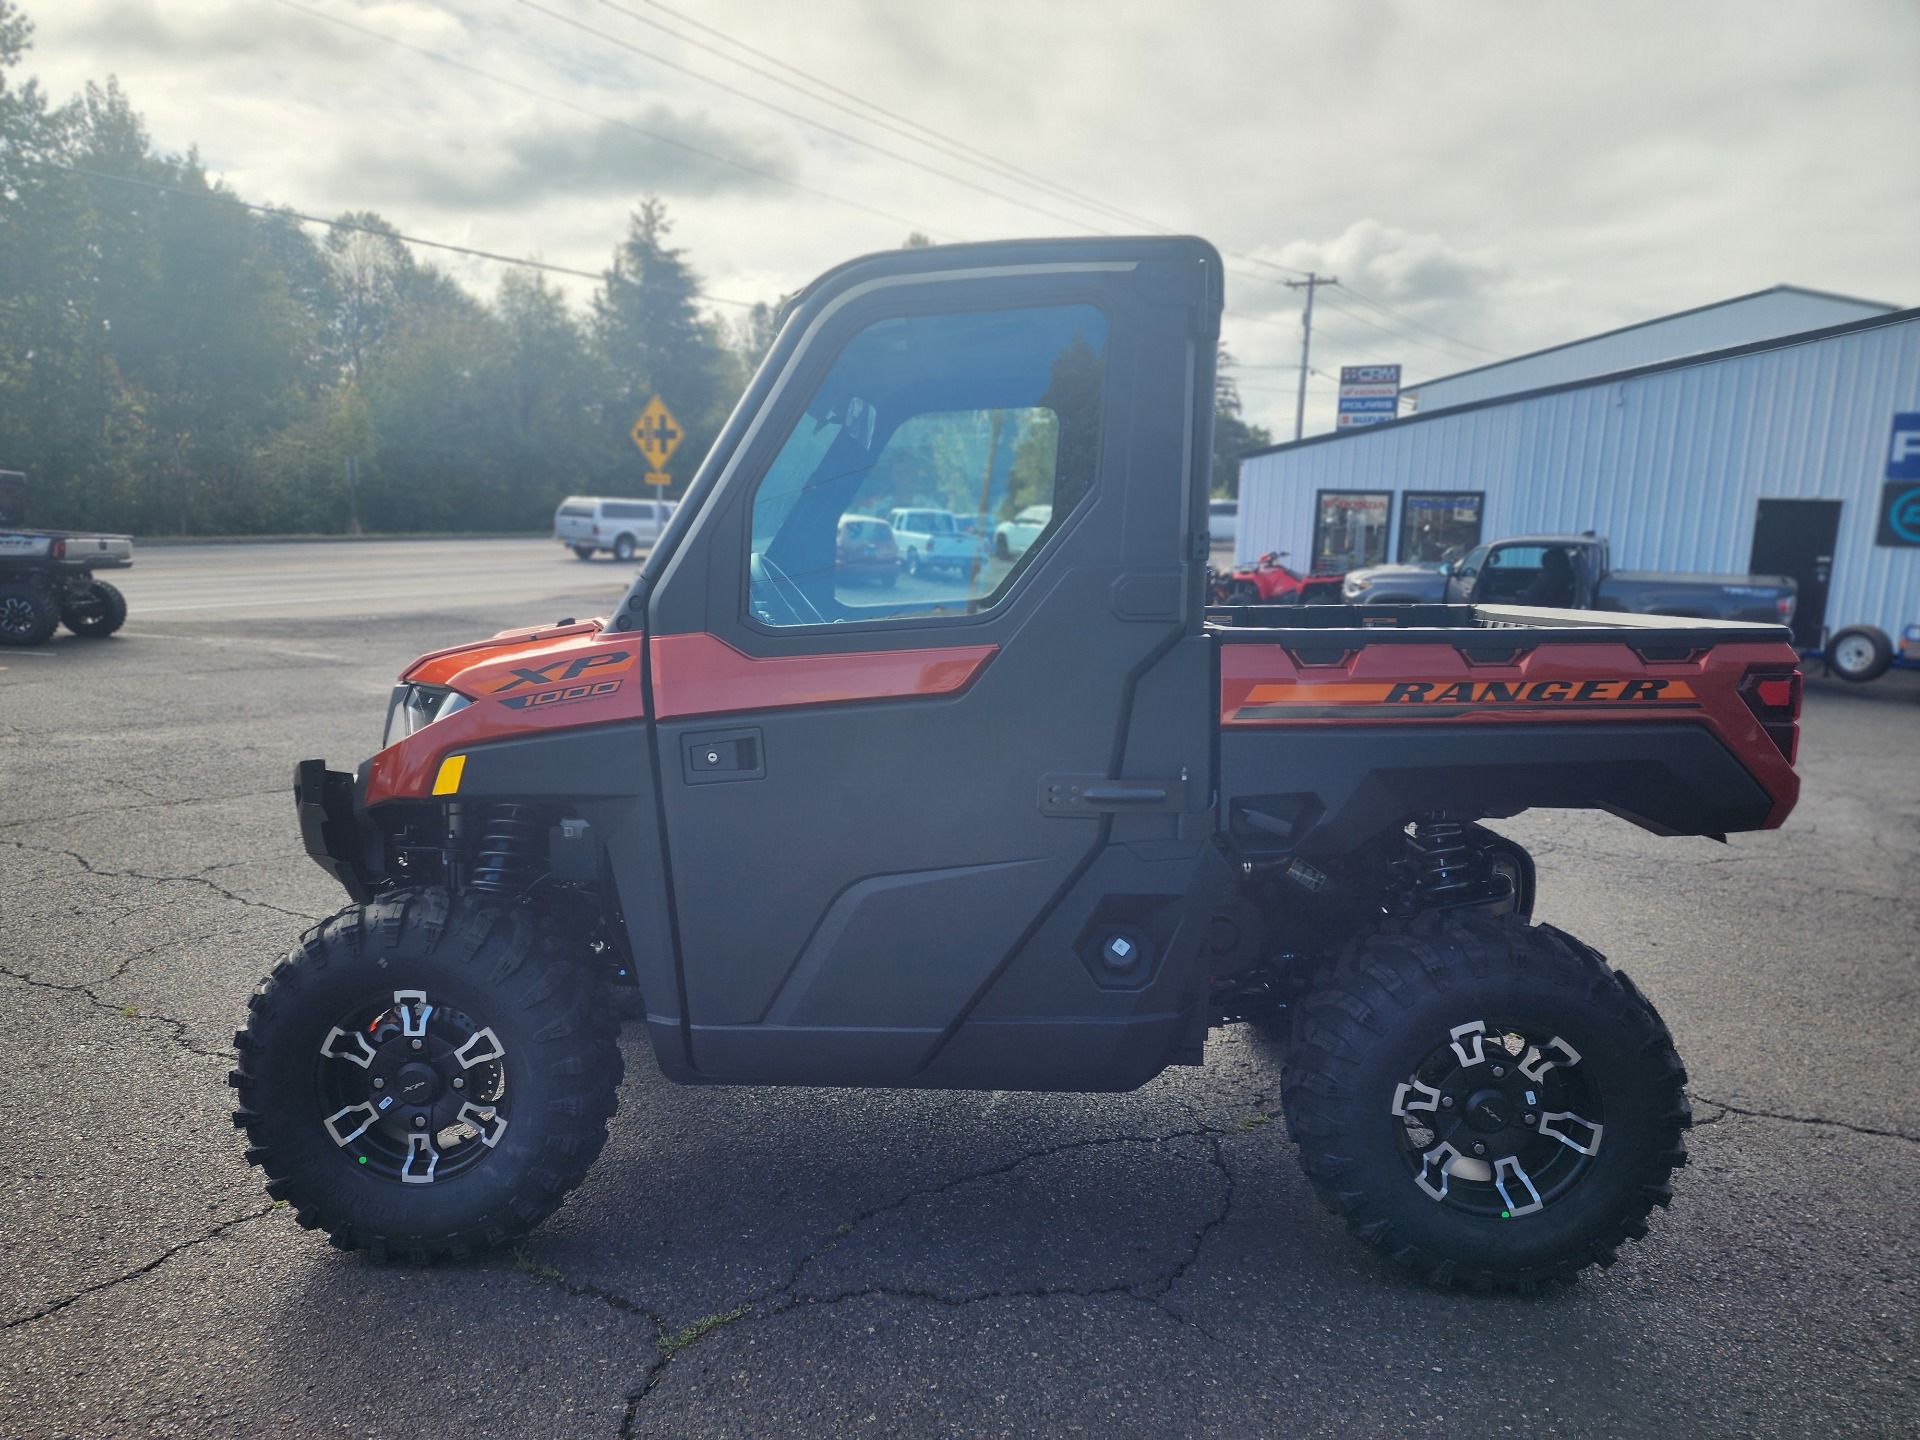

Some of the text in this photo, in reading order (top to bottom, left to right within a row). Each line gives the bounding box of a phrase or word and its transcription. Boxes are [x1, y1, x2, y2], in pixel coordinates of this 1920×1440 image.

[1359, 367, 1396, 380] CRM
[1341, 400, 1393, 410] POLARIS
[490, 651, 631, 693] XP
[524, 680, 622, 707] 1000
[1383, 679, 1670, 703] RANGER
[402, 1081, 425, 1093] XP
